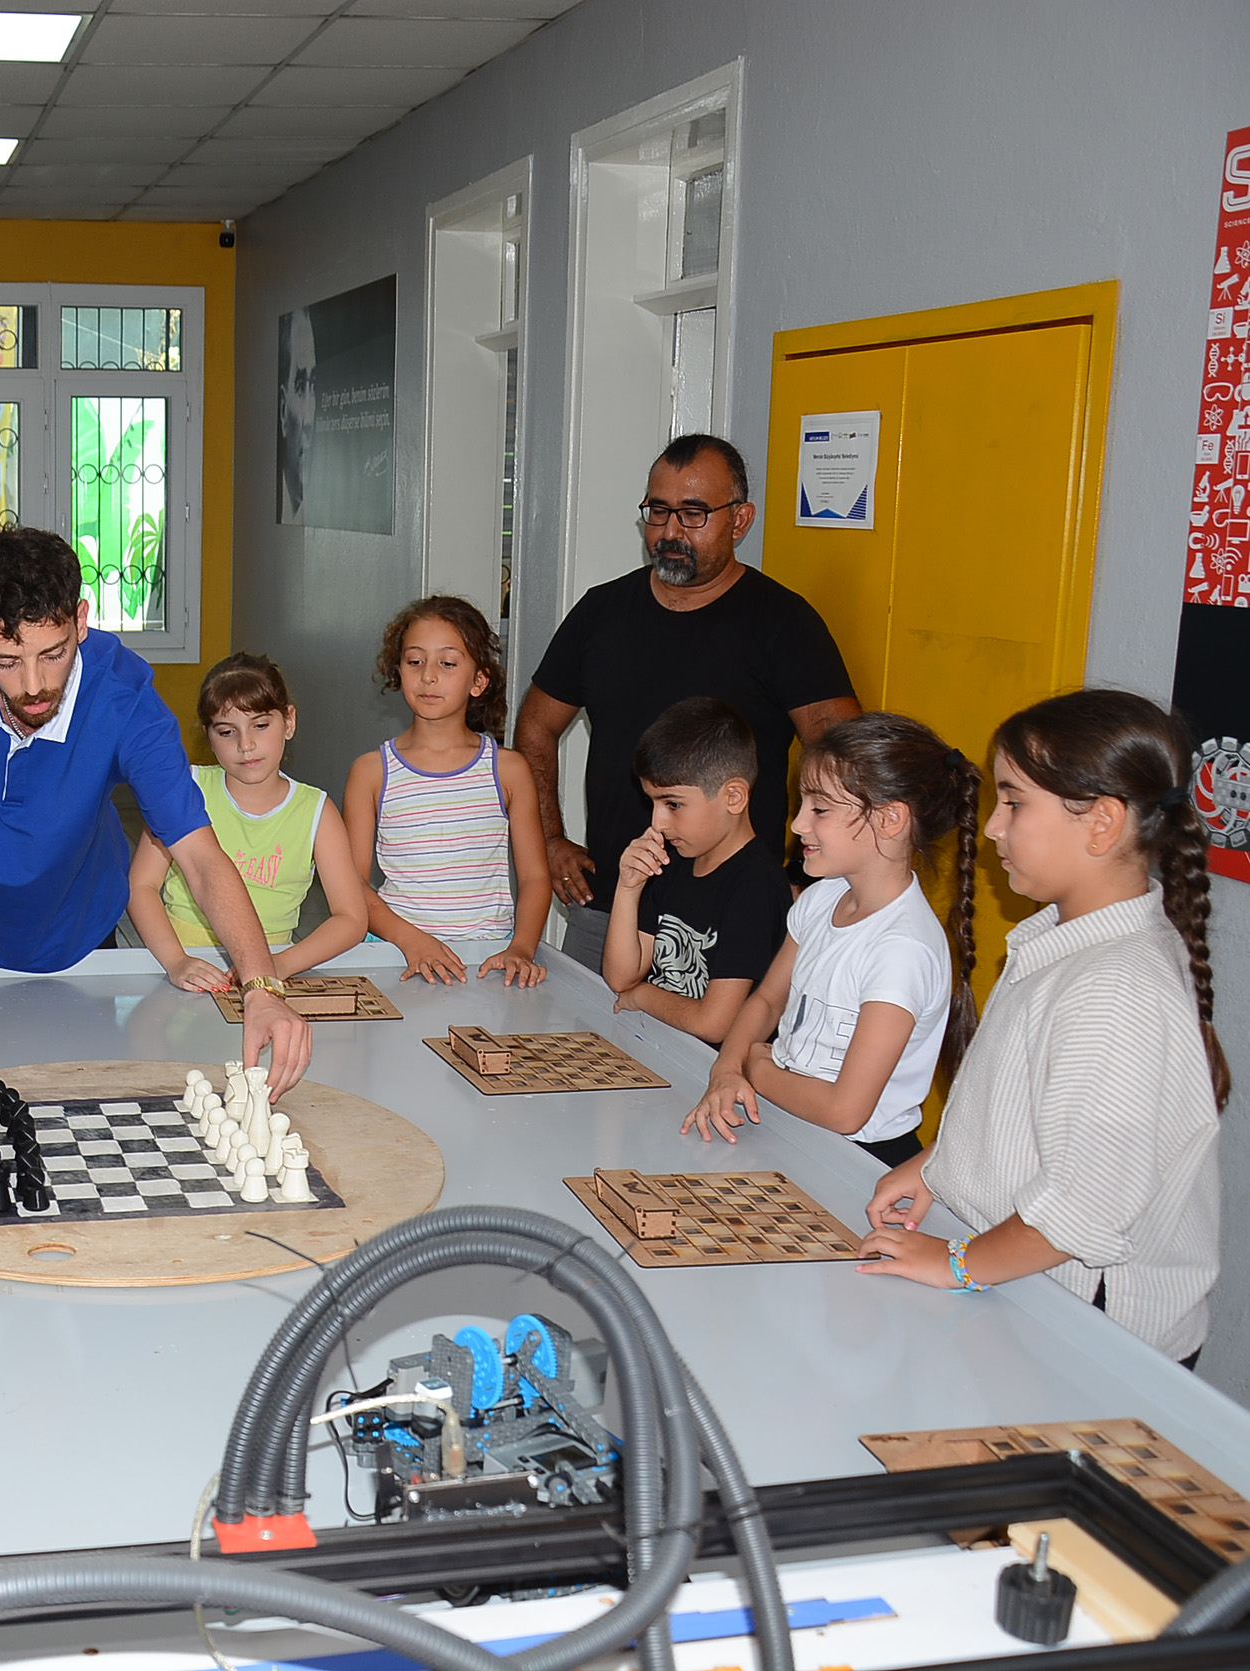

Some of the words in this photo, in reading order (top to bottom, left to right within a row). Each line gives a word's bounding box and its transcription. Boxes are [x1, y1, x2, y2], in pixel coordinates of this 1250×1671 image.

[1215, 312, 1226, 325] Si
[1201, 440, 1215, 451] Fe
[246, 855, 283, 888] EASY
